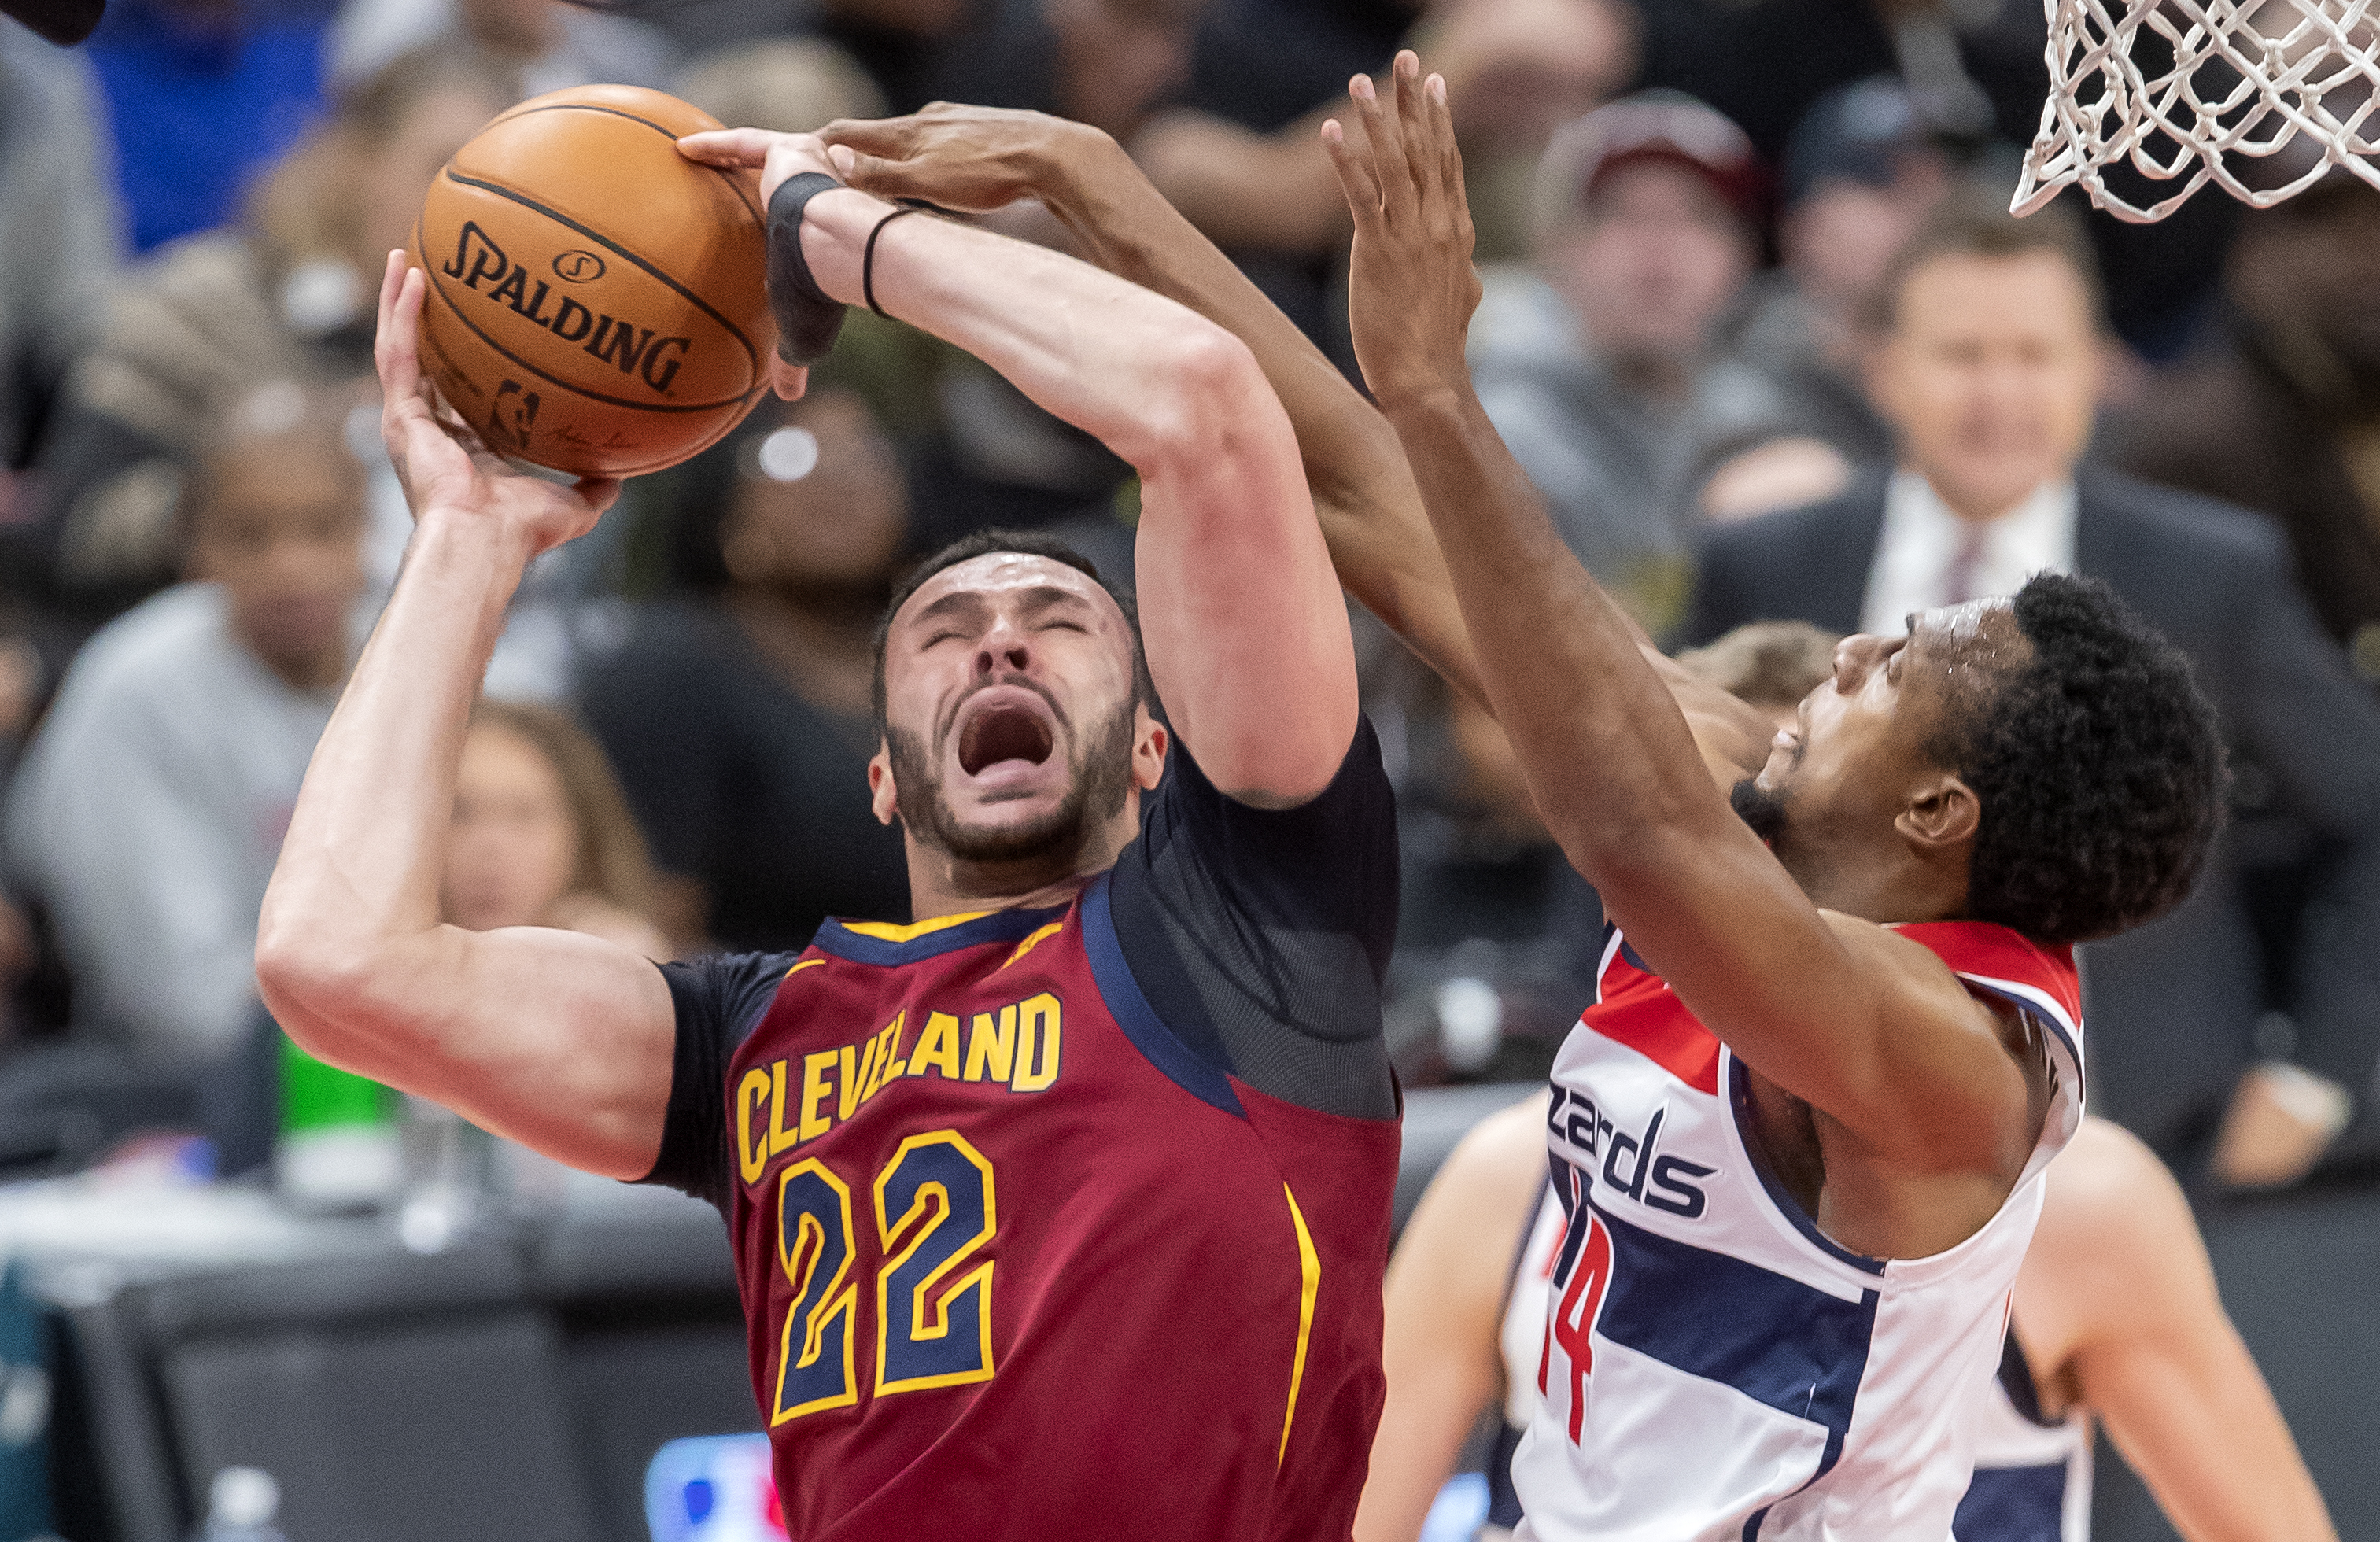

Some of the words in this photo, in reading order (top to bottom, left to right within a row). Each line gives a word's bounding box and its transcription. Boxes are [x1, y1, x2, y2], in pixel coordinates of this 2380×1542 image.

[442, 220, 692, 393] SPALDING
[736, 991, 1062, 1185] CLEVELAND
[770, 1128, 997, 1428] 22
